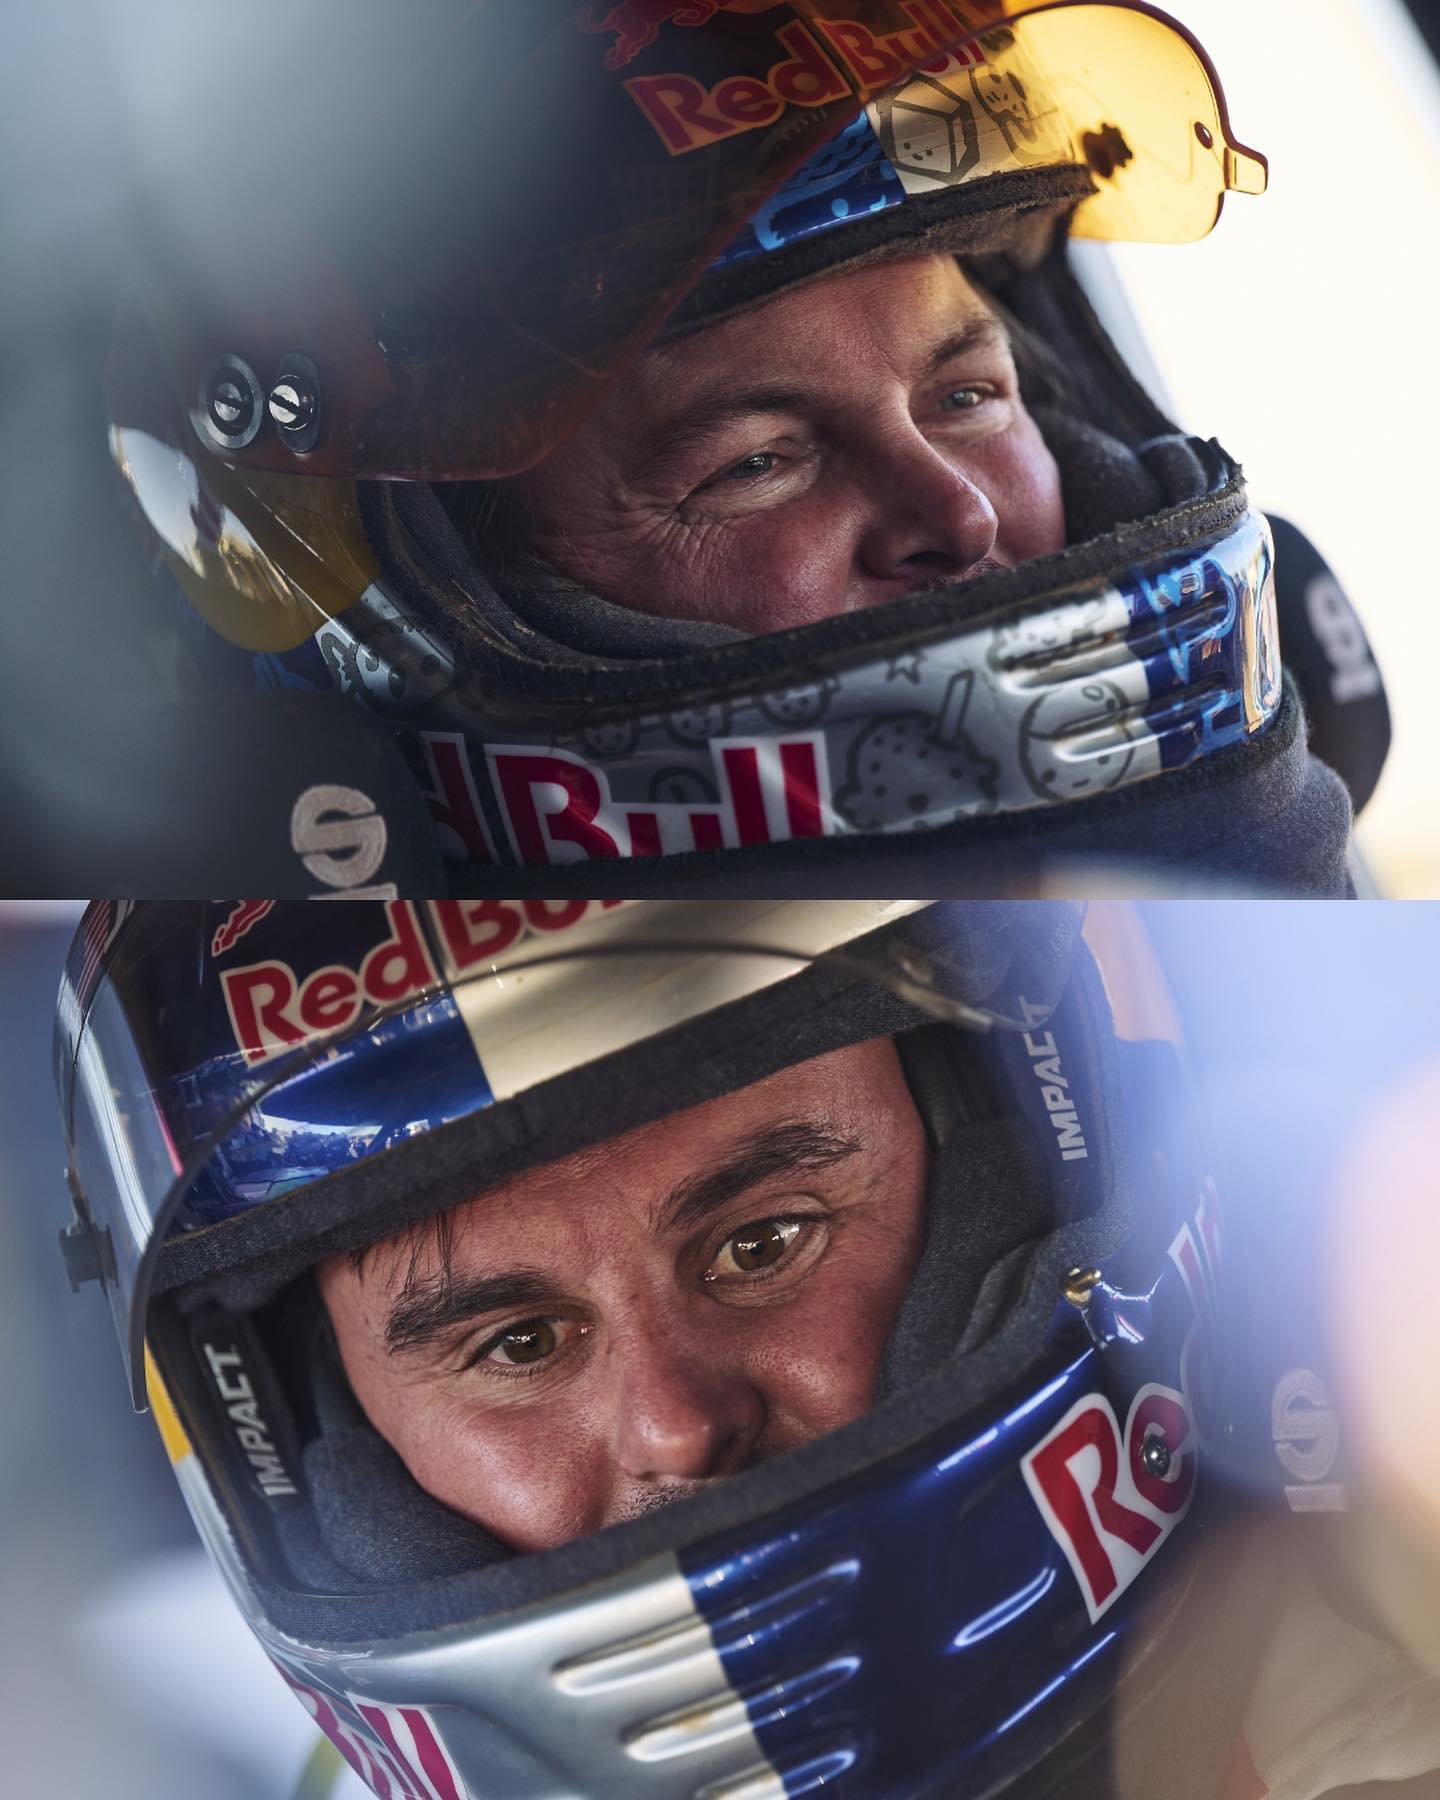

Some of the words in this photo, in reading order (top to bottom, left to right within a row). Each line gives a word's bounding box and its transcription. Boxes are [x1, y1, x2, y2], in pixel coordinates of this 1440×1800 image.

[622, 18, 858, 157] Red
[811, 0, 988, 90] Bull
[219, 900, 439, 1068] Red
[1017, 994, 1089, 1162] IMPACT
[203, 1343, 298, 1498] IMPACT
